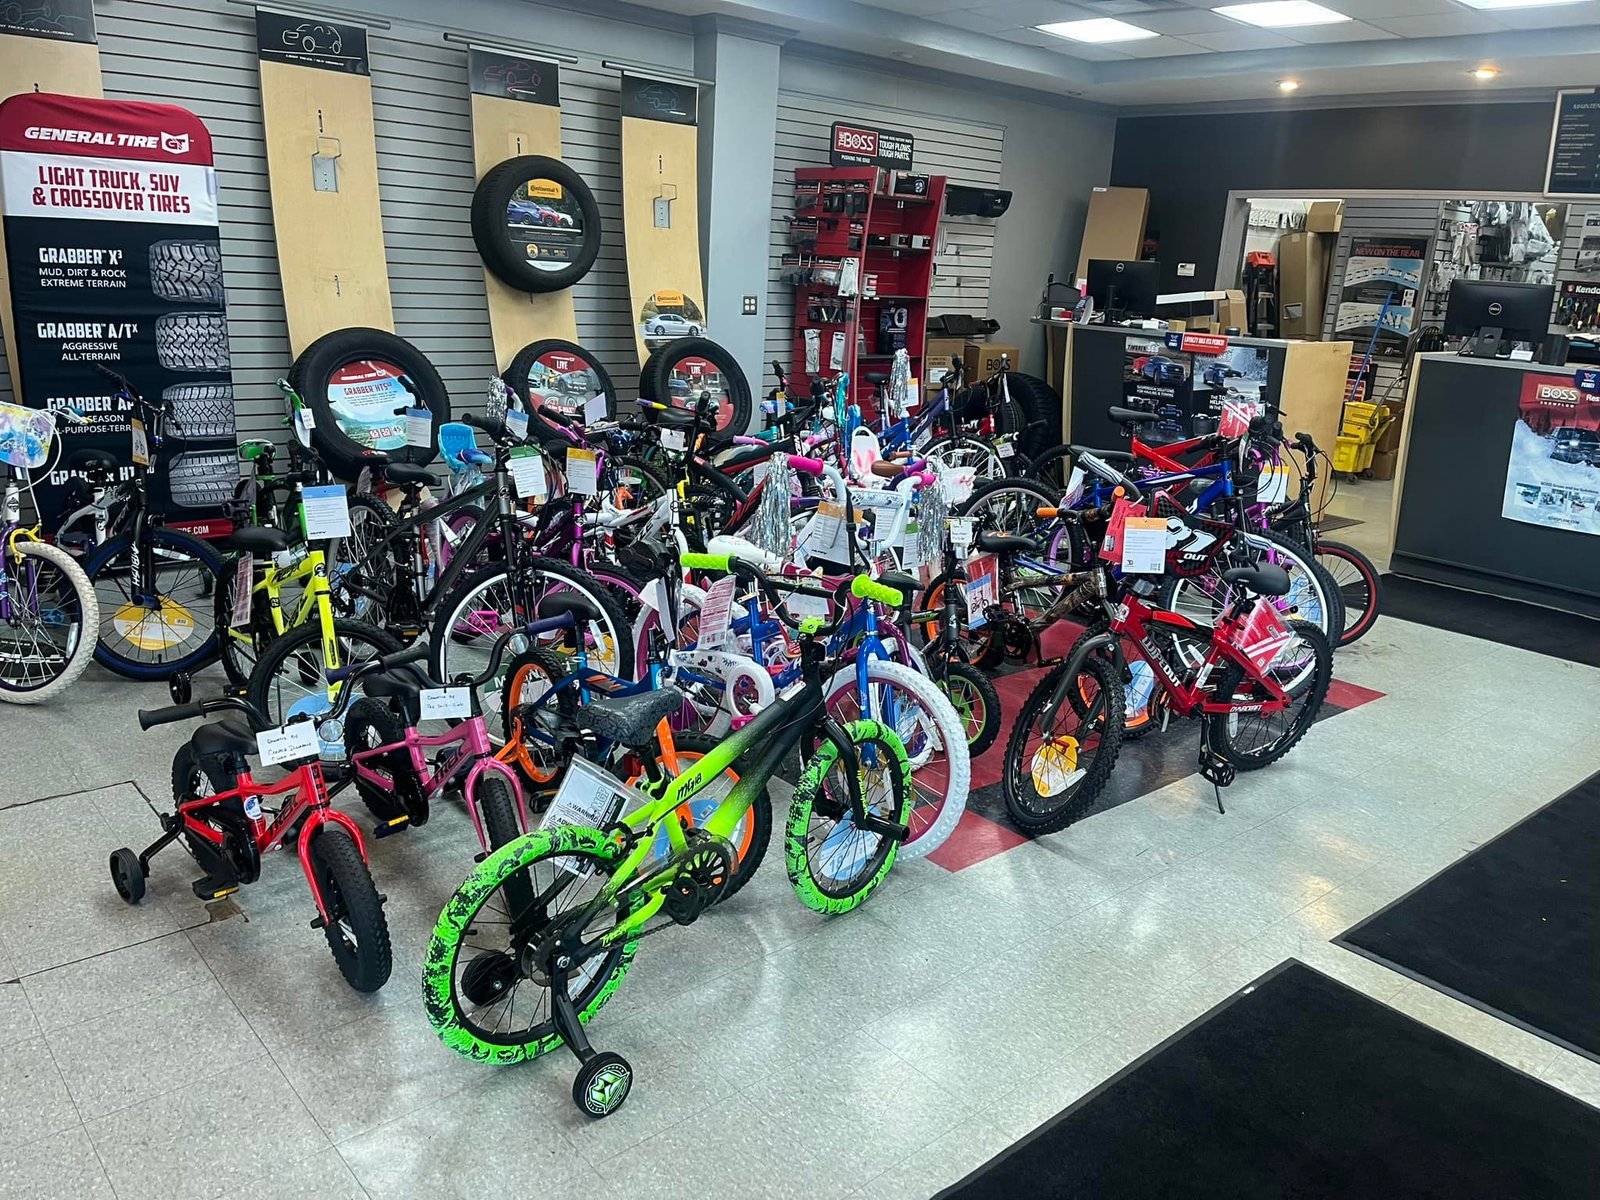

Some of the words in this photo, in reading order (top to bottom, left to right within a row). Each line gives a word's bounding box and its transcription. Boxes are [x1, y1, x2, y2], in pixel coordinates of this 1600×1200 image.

[24, 126, 115, 146] GENERAL
[117, 133, 160, 149] TIRE
[844, 132, 874, 151] BOSS
[879, 140, 894, 150] TOUGH
[879, 149, 894, 158] TOUGH
[38, 165, 84, 187] LIGHT
[89, 169, 146, 192] TRUCK,
[150, 173, 180, 193] SUV
[32, 187, 47, 206] &
[51, 188, 144, 211] CROSSOVER
[147, 193, 191, 214] TIRES
[39, 247, 103, 265] GRABBER
[39, 268, 65, 278] MUD,
[67, 268, 89, 277] DIRT
[91, 269, 99, 277] &
[101, 269, 126, 278] ROCK
[41, 279, 84, 288] EXTREME
[86, 280, 126, 288] TERRAIN
[37, 323, 102, 339] GRABBER
[62, 341, 118, 351] AGGRESSIVE
[61, 352, 121, 361] ALL-TERRAIN
[556, 360, 569, 370] LIVE
[344, 386, 374, 396] GRABBER
[1541, 386, 1578, 401] BOSS
[1183, 552, 1209, 561] OUT
[1139, 636, 1181, 687] WIPEOUT
[572, 803, 599, 823] WARNING
